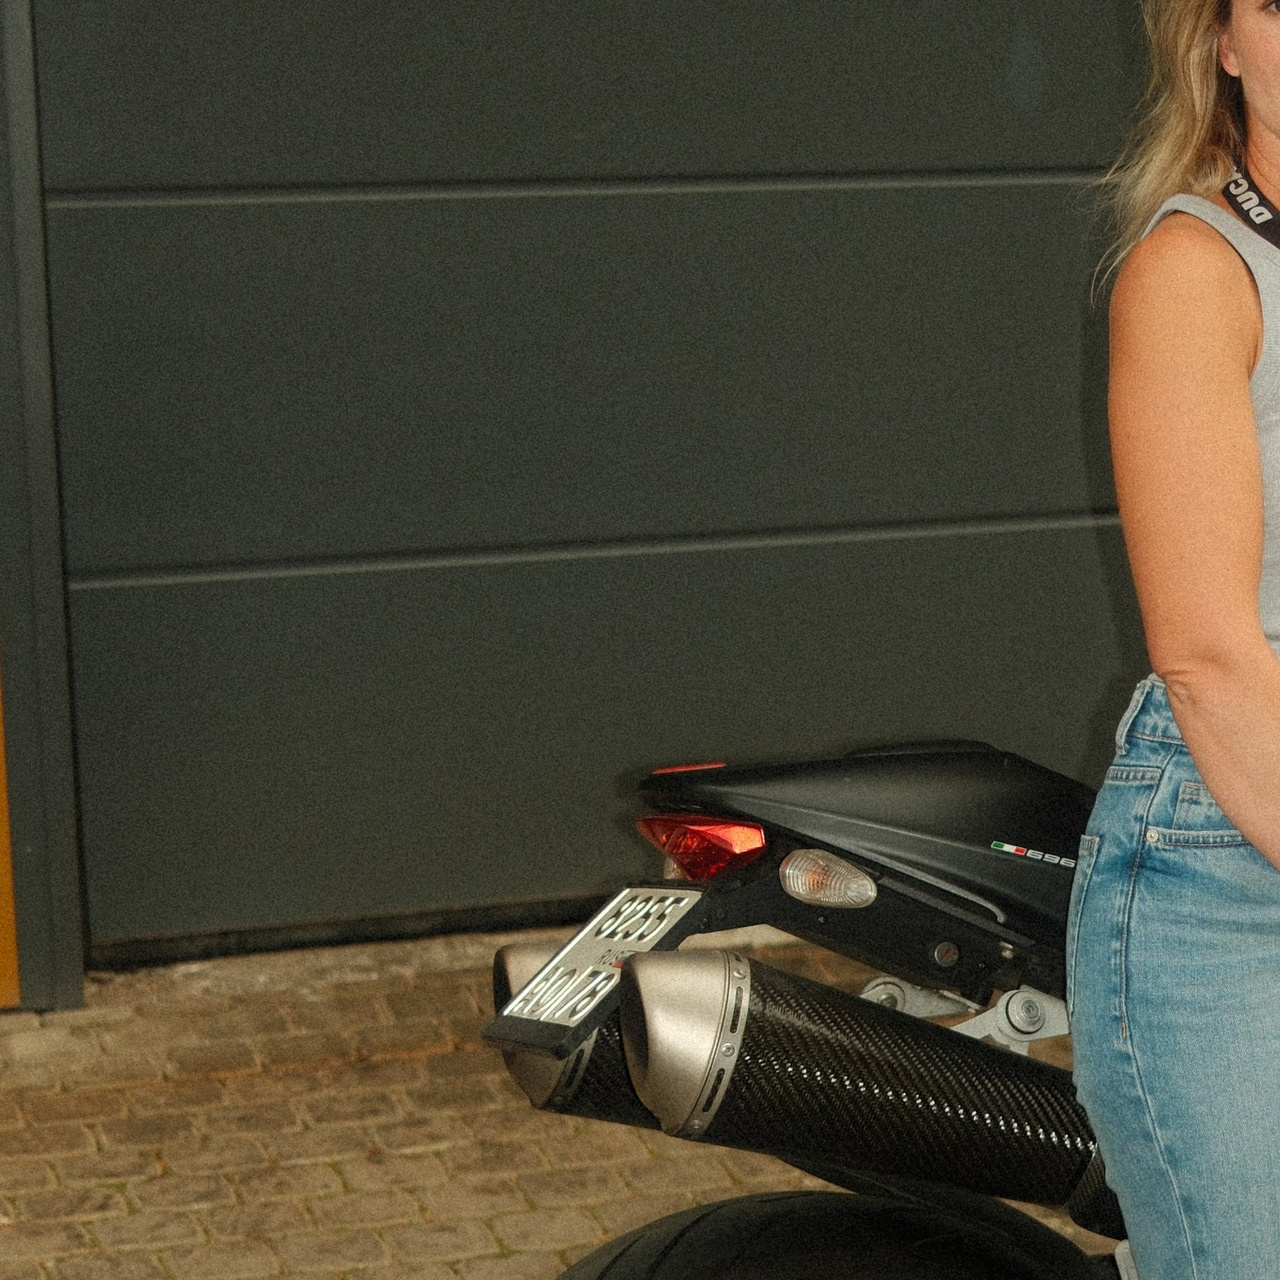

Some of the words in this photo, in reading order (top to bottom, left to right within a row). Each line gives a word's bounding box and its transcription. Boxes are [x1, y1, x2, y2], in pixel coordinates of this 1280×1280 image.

[1026, 849, 1076, 868] 696
[595, 896, 689, 943] 8255
[600, 949, 625, 967] RUS
